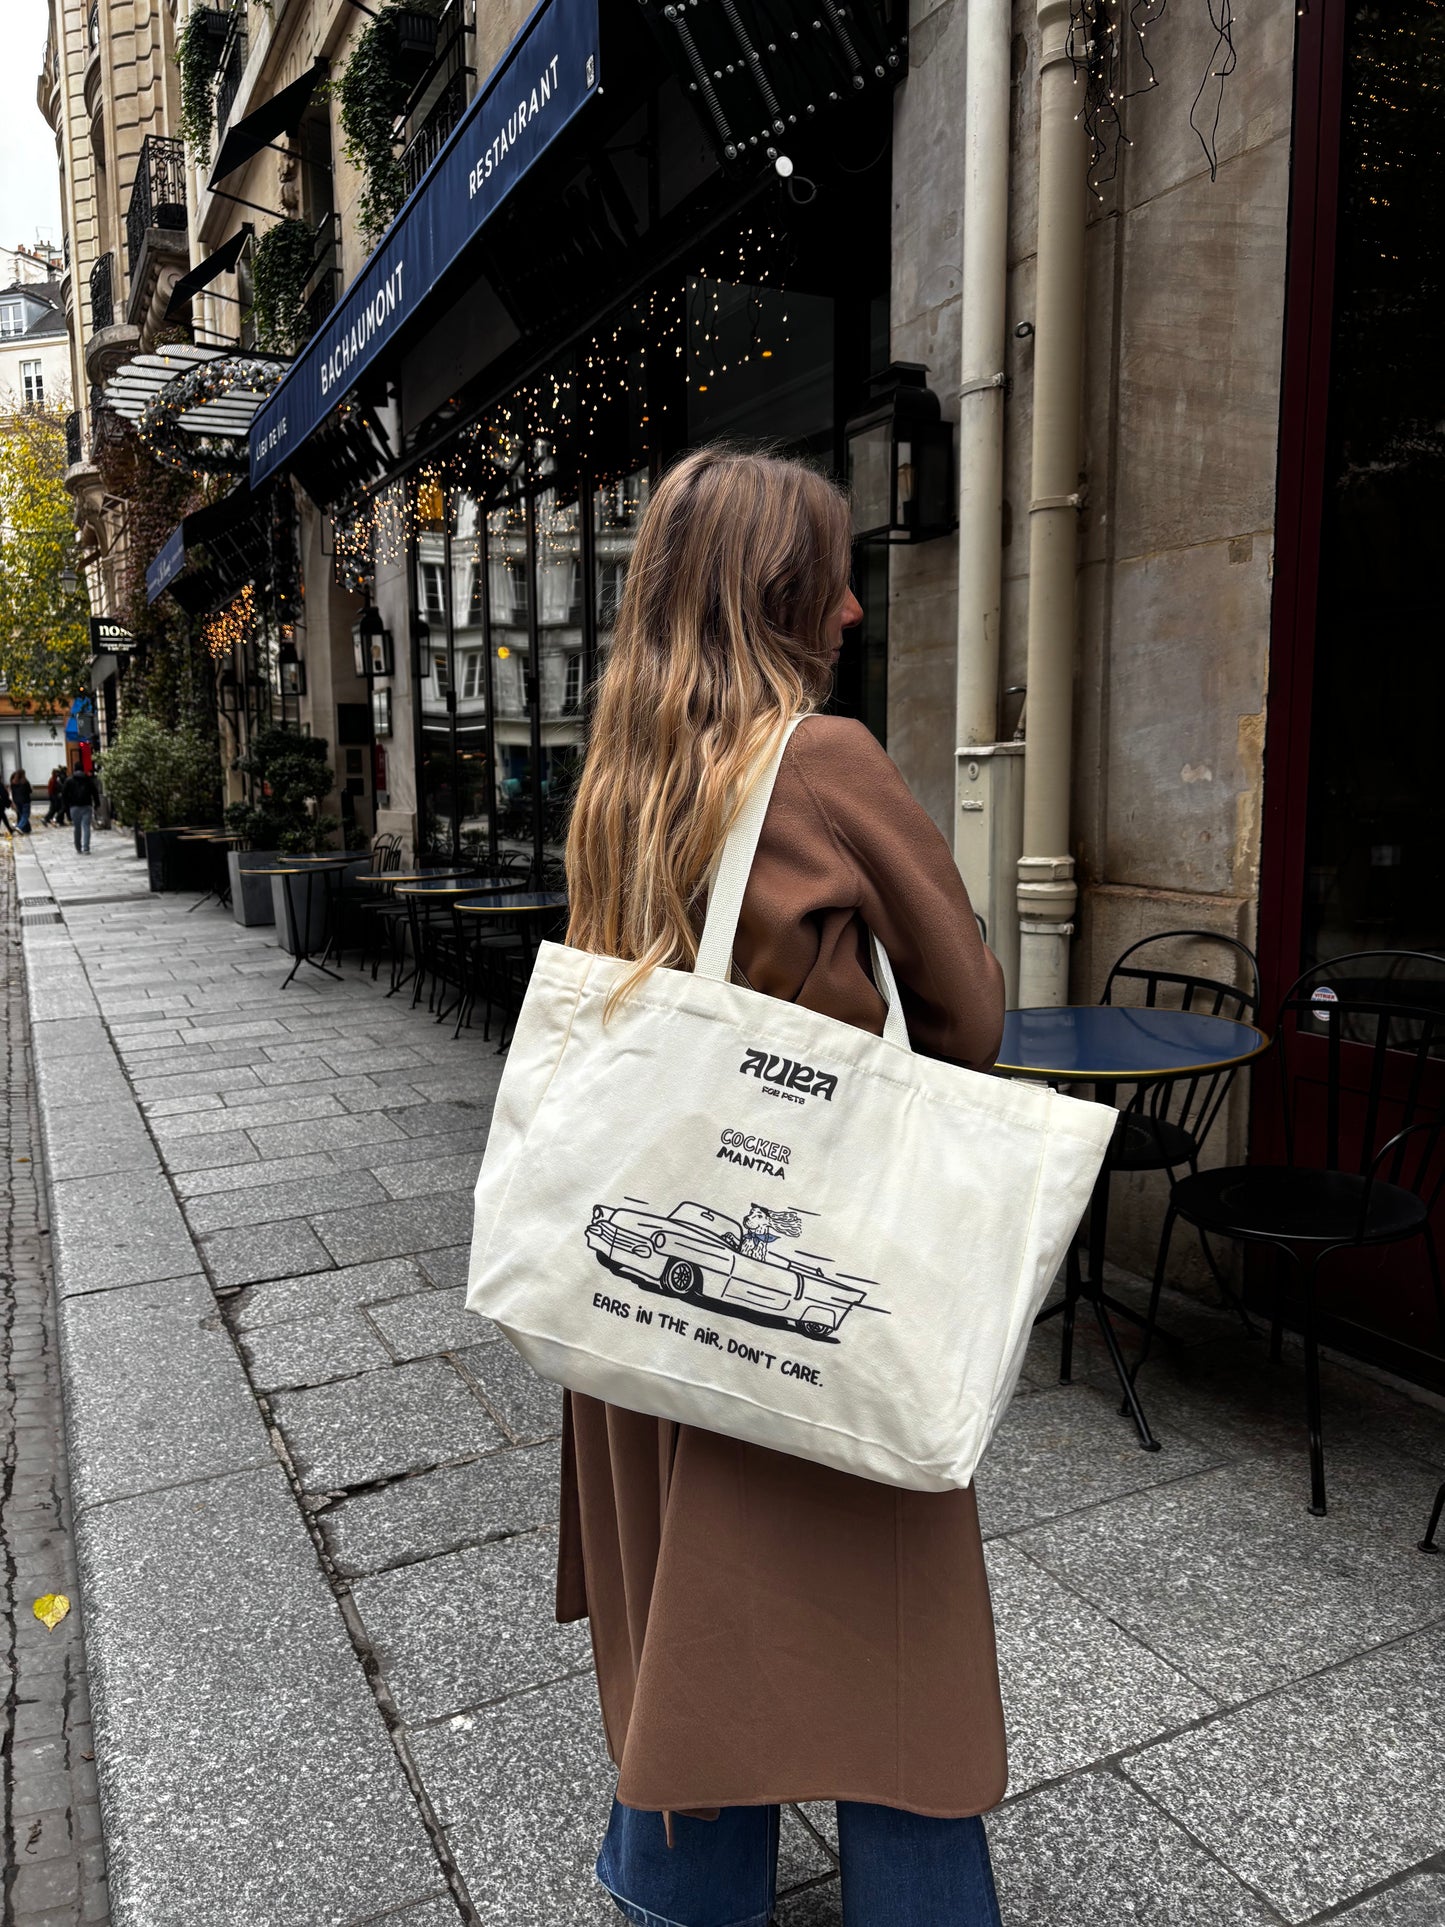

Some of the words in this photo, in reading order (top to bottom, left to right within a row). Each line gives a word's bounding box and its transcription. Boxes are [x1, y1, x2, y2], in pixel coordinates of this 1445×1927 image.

[469, 54, 559, 200] RESTAURANT
[320, 260, 404, 396] BACHAUMONT
[255, 436, 268, 462] LIEU
[268, 427, 277, 449] DE
[739, 1047, 839, 1102] AURA
[761, 1085, 781, 1098] FOR
[781, 1092, 806, 1105] PETS
[716, 1145, 785, 1180] MANTRA
[720, 1128, 792, 1165] COCKER
[592, 1292, 631, 1319] EARS
[658, 1313, 689, 1336] THE
[727, 1338, 777, 1369] DON'T
[780, 1360, 823, 1387] CARE.
